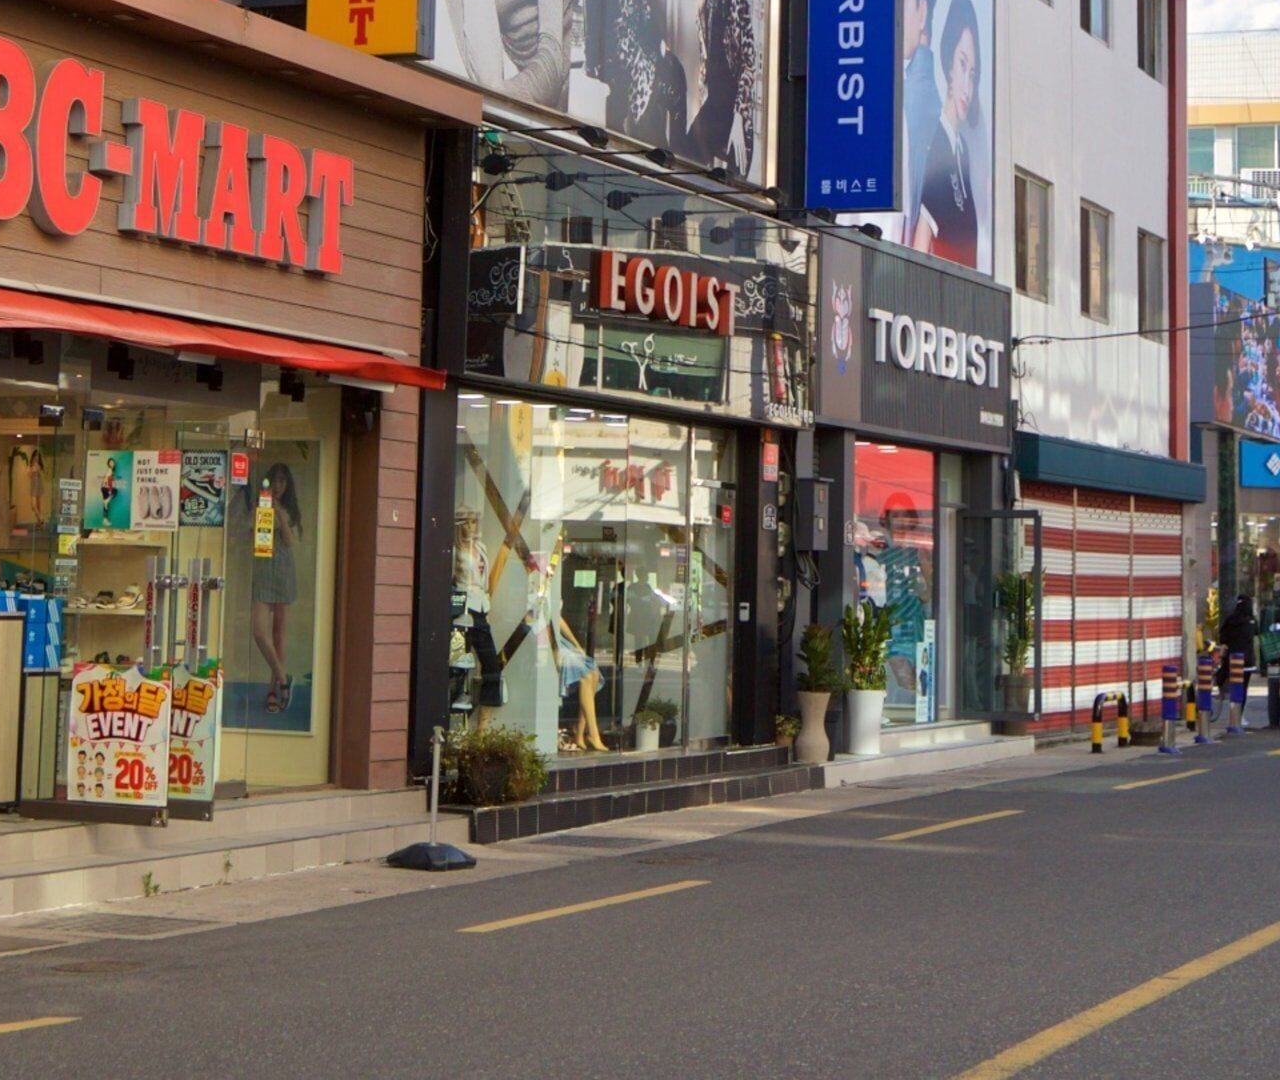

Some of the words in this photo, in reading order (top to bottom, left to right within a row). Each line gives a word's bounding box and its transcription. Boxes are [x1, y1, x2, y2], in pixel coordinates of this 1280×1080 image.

[599, 250, 741, 336] EGOIST
[868, 308, 1005, 388] TORBIST
[184, 455, 198, 466] OLD
[199, 455, 222, 467] SKOOL
[86, 711, 153, 744] EVENT
